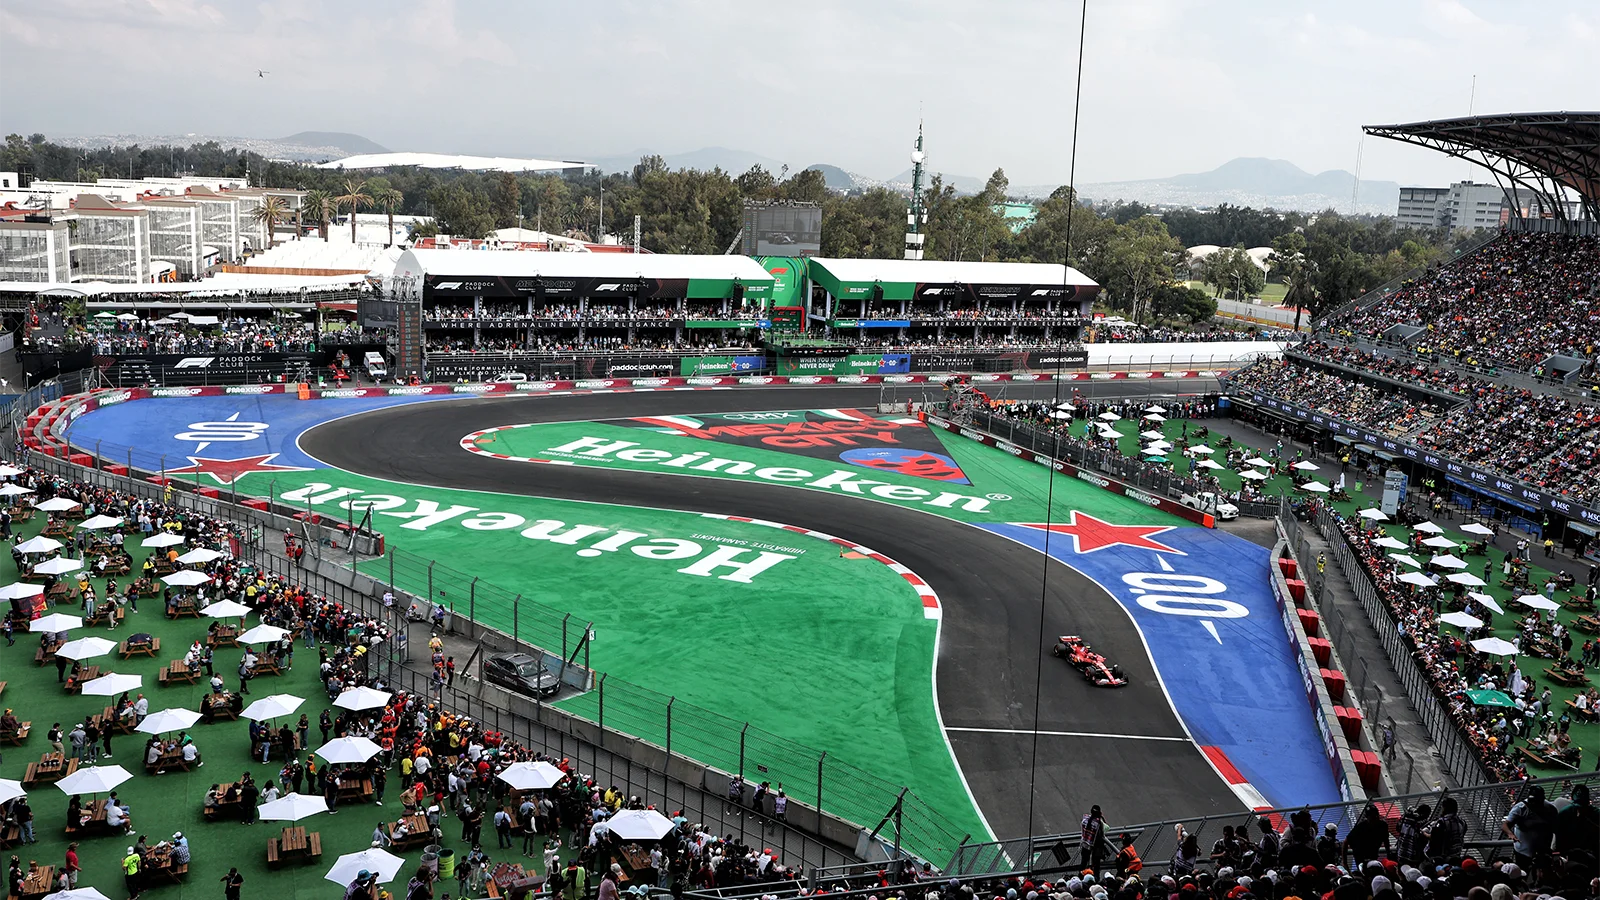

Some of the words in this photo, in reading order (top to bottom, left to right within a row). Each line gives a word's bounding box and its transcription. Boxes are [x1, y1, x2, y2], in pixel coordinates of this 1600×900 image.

[515, 382, 557, 390] #MexicoGP
[575, 380, 614, 388] #MexicoGP
[632, 378, 669, 386] #MexicoGP
[152, 387, 202, 396] #MexicoGP
[226, 386, 274, 394] #MexicoGP
[321, 389, 367, 397] #MexicoGP
[388, 387, 433, 395] #MexicoGP
[927, 416, 950, 429] #MexicoGP
[687, 419, 902, 439] MEXICO
[760, 431, 903, 448] CITY
[959, 428, 985, 442] #MexicoGP
[995, 440, 1022, 455] #MexicoGP
[1428, 456, 1440, 465] MSC
[1451, 464, 1463, 473] MSC
[1077, 470, 1110, 488] #MexicoGP
[1475, 473, 1488, 482] MSC
[1500, 481, 1514, 491] MSC
[1125, 488, 1161, 506] #MexicoGP
[1527, 490, 1541, 501] MSC
[1556, 500, 1571, 512] MSC
[1586, 511, 1600, 523] MSC
[280, 482, 798, 584] Heineken
